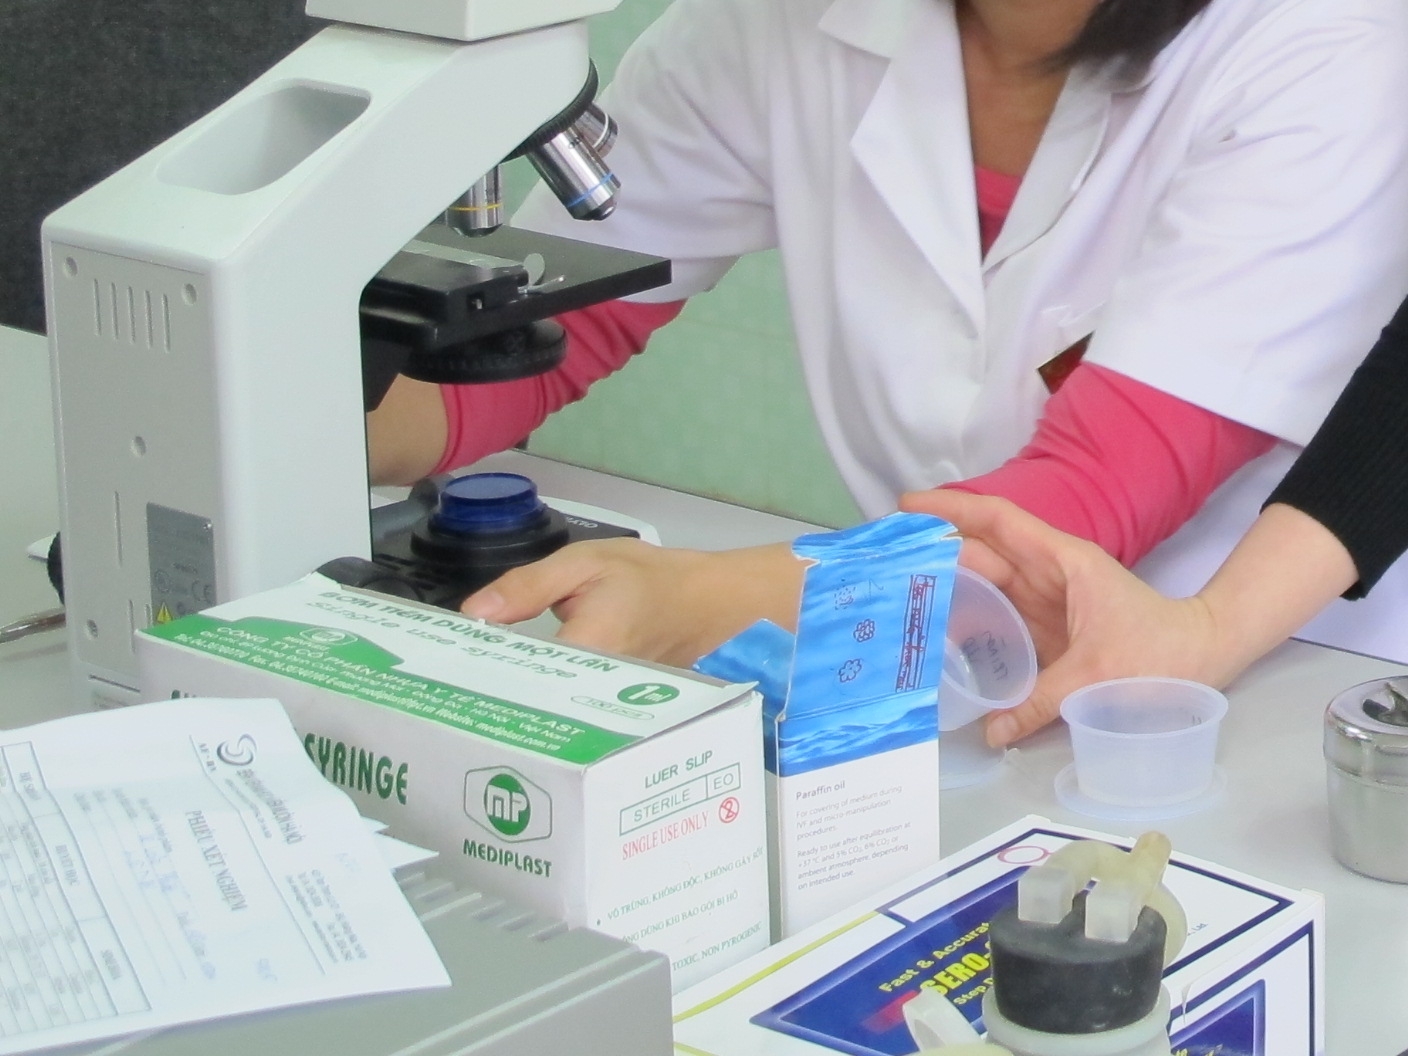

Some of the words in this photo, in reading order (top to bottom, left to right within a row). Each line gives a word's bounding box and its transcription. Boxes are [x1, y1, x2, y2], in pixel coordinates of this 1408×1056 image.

[306, 601, 401, 628] Single
[405, 627, 458, 646] use
[461, 645, 578, 679] syringe
[318, 591, 379, 608] BƠM
[379, 604, 434, 623] TIÊM
[432, 619, 507, 644] DÙNG
[505, 641, 568, 661] MỘT
[566, 653, 620, 673] LẦN
[216, 626, 270, 643] CÔNG
[271, 640, 296, 651] TY
[295, 648, 329, 659] CỔ
[323, 656, 377, 675] PHẦN
[375, 672, 429, 691] NHỰA
[433, 687, 449, 695] Y
[449, 691, 480, 704] TẾ
[473, 700, 586, 735] MEDIPLAST
[303, 731, 409, 805] SYRINGE
[644, 764, 680, 789] LUER
[686, 750, 713, 772] SLIP
[713, 773, 735, 790] EO
[633, 788, 692, 822] STERILE
[796, 784, 833, 801] Paraffin
[833, 779, 846, 791] oil
[796, 809, 809, 819] For
[809, 801, 840, 816] covering
[840, 797, 850, 807] of
[849, 791, 879, 805] medium
[878, 785, 903, 798] during
[622, 832, 660, 861] SINGLE
[660, 823, 680, 845] USE
[680, 811, 710, 836] ONLY
[808, 815, 823, 827] and
[463, 838, 553, 878] MEDIPLAST
[797, 845, 820, 859] Ready
[819, 843, 829, 851] to
[828, 841, 841, 850] use
[841, 836, 859, 846] after
[859, 822, 903, 842] equilibration
[903, 821, 912, 829] at
[821, 852, 836, 862] and
[890, 835, 900, 843] or
[798, 866, 828, 880] ambient
[871, 844, 910, 862] depending
[651, 883, 682, 903] KHÔNG
[703, 862, 734, 882] KHÔNG
[797, 880, 809, 891] on
[808, 872, 841, 889] intended
[640, 921, 665, 939] DÙNG
[665, 915, 681, 928] KHI
[681, 907, 700, 921] BAO
[701, 944, 721, 959] NON
[720, 920, 763, 951] PYROGENIC
[878, 968, 920, 992] Fast
[916, 959, 935, 969] &
[919, 940, 992, 996] SERO-
[952, 985, 987, 1005] Step
